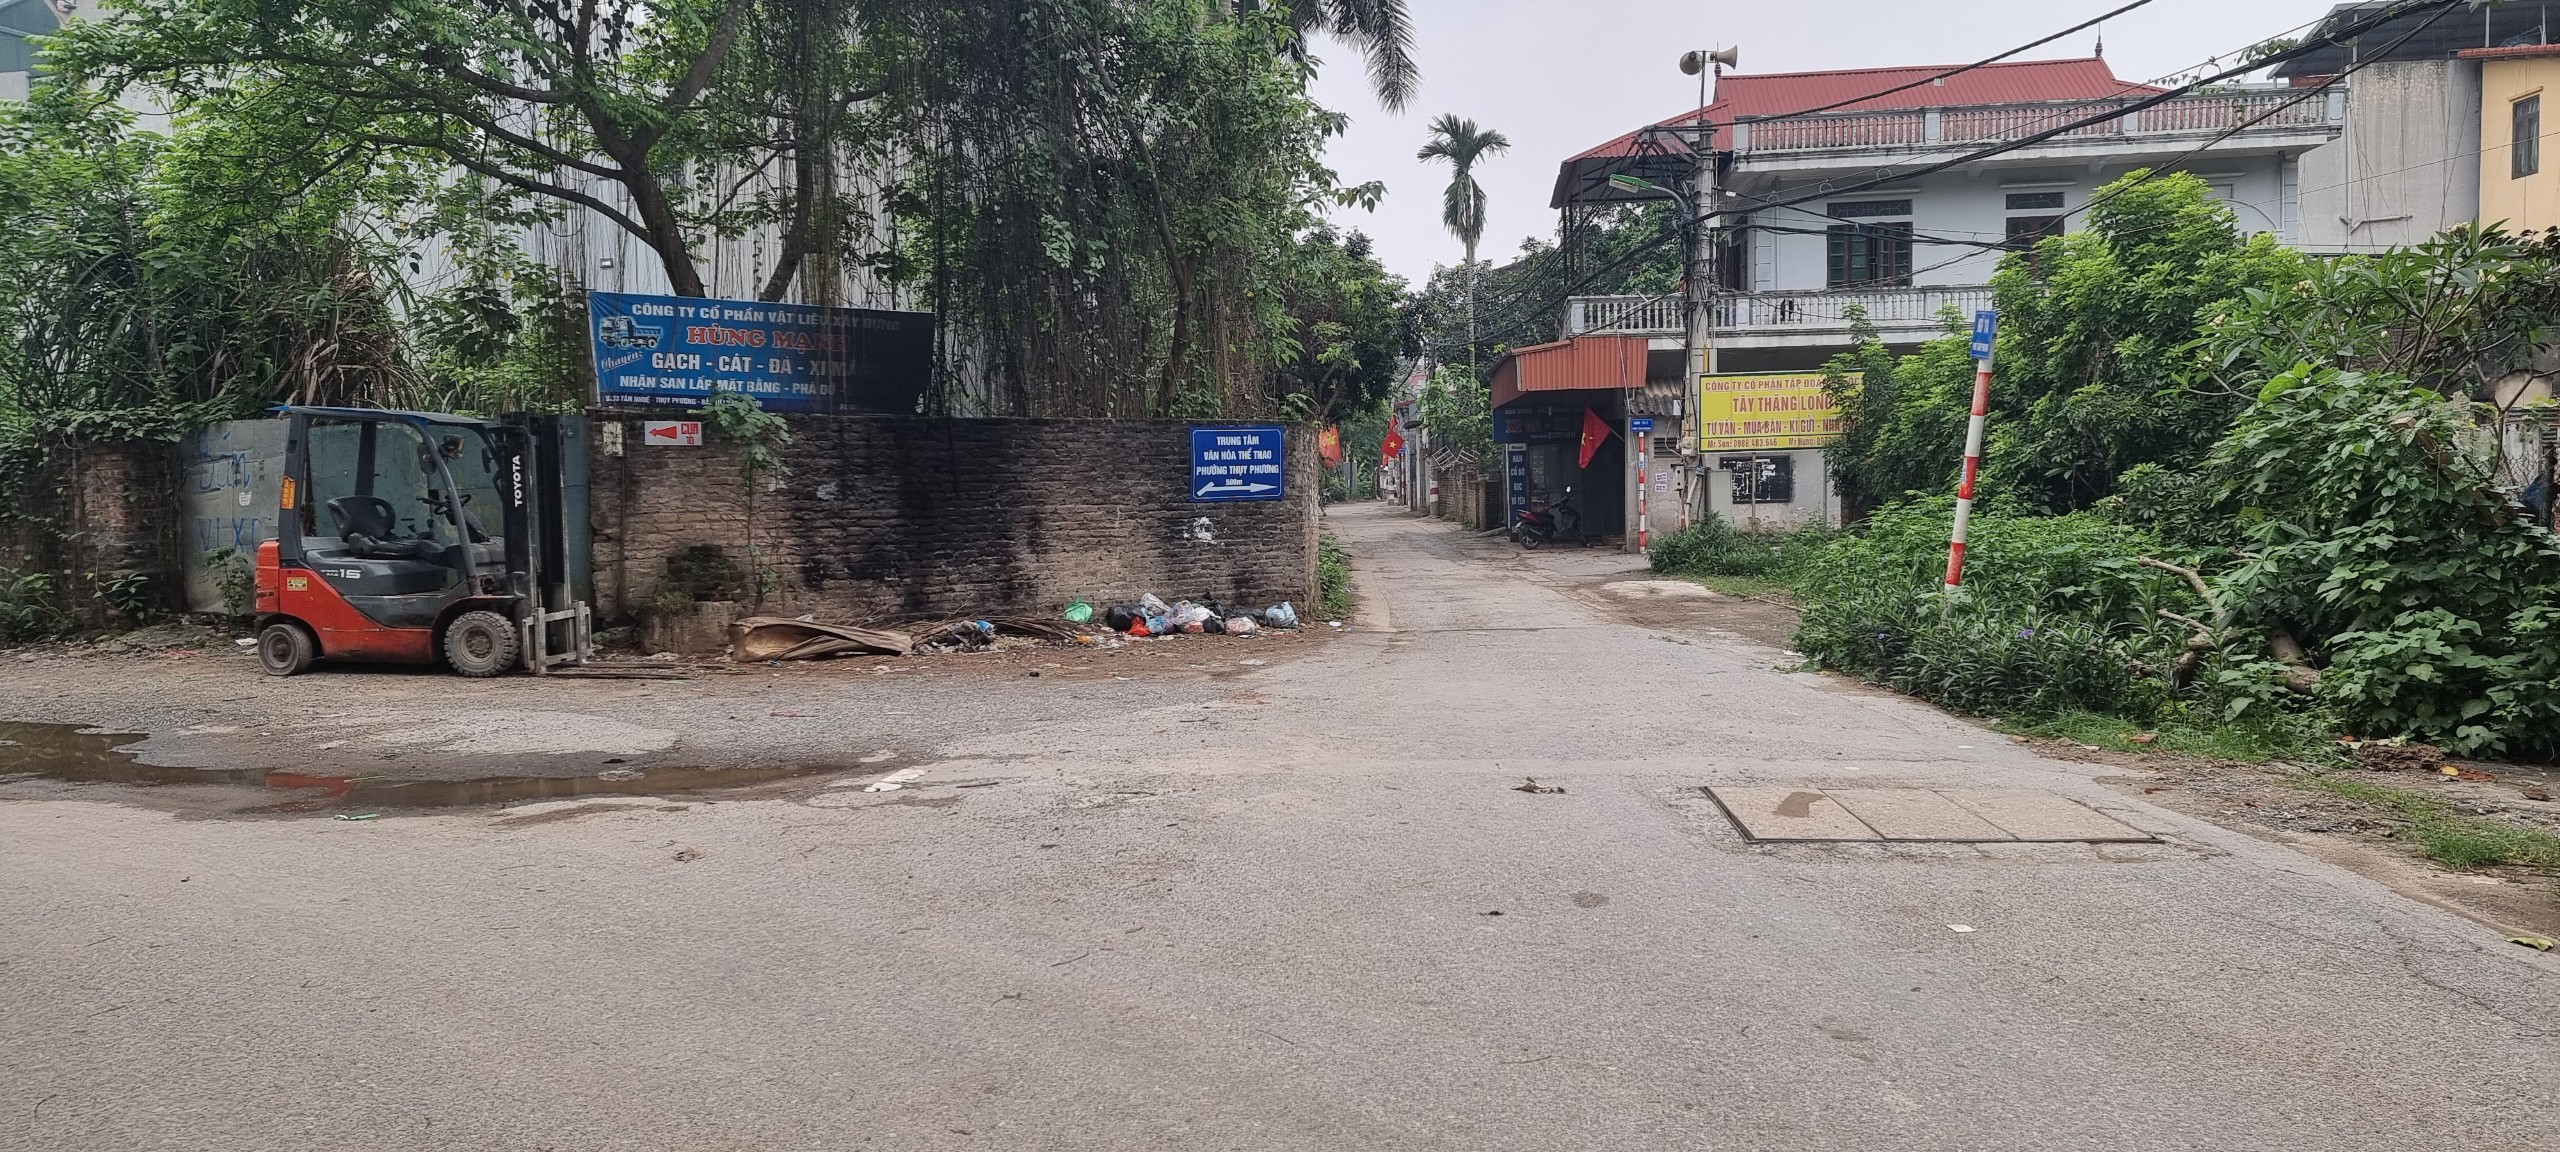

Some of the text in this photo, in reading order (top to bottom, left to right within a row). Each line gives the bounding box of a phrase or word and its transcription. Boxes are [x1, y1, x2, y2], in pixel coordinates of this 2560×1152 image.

[632, 303, 674, 317] CÔNG
[678, 306, 695, 318] TY
[700, 304, 720, 319] CỔ
[724, 307, 764, 322] PHẦN
[768, 310, 795, 325] VẬT
[652, 352, 700, 372] GẠCH
[718, 353, 752, 373] CÁT
[769, 356, 792, 374] ĐÁ
[620, 374, 656, 390] NHẬN
[660, 377, 686, 389] SAN
[747, 377, 781, 393] BẰNG
[792, 382, 816, 395] PHÁ
[1706, 380, 1730, 391] CÔNG
[1732, 381, 1742, 390] TY
[1785, 378, 1801, 390] TẬP
[1733, 395, 1754, 412] TÂY
[1758, 394, 1797, 412] THĂNG
[1744, 421, 1762, 434] MUA
[1764, 418, 1782, 433] BÁN
[1217, 434, 1259, 445] TRUNG TÂM
[1204, 447, 1272, 460] VĂN HÓA THỂ THAO
[1196, 464, 1279, 476] PHƯỜNG THỤY PHƯƠNG
[512, 454, 522, 507] TOYOTA
[340, 569, 362, 579] 15
